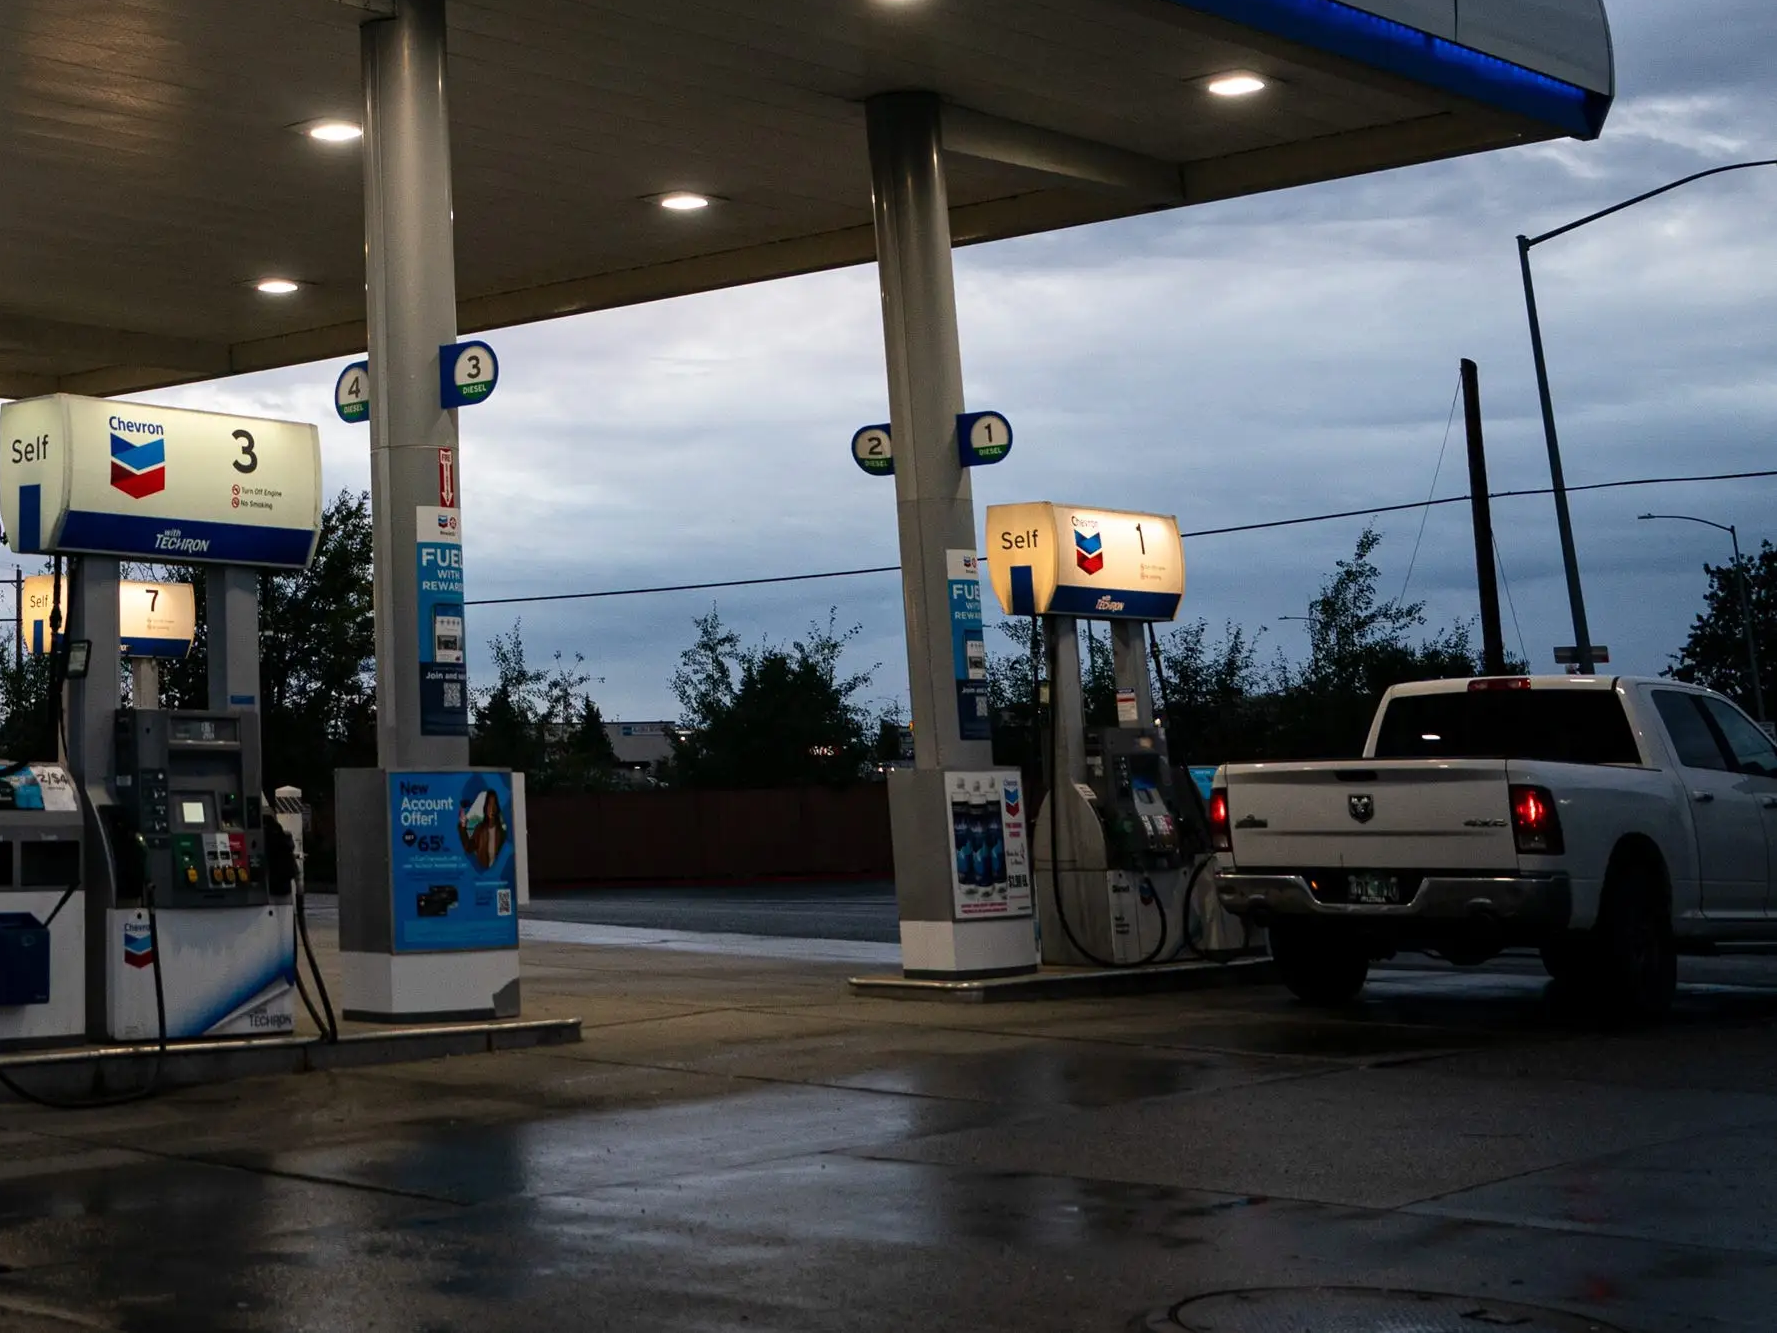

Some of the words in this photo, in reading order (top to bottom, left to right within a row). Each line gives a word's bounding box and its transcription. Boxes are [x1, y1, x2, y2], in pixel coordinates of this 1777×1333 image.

[467, 355, 481, 379] 3
[348, 376, 361, 398] 4
[462, 384, 487, 395] DIESEL
[344, 404, 364, 415] DIESEL
[109, 416, 164, 435] Chevron
[984, 423, 993, 443] 1
[12, 434, 49, 464] Self
[232, 429, 257, 474] 3
[867, 437, 883, 455] 2
[979, 446, 1003, 456] DIESEL
[264, 489, 282, 497] Engine
[240, 499, 249, 507] No
[249, 500, 273, 510] Smoking
[164, 528, 182, 537] with
[1001, 529, 1039, 550] Self
[1136, 523, 1146, 555] 1
[155, 534, 210, 554] TECHRON
[437, 569, 461, 580] WITH
[953, 584, 980, 600] FUE
[30, 594, 48, 609] Self
[145, 589, 159, 612] 7
[425, 671, 444, 680] Join
[400, 781, 429, 795] New
[401, 797, 454, 811] Account
[401, 813, 438, 827] Offer!
[124, 923, 151, 932] Chevro
[250, 1014, 292, 1029] TECHRON
